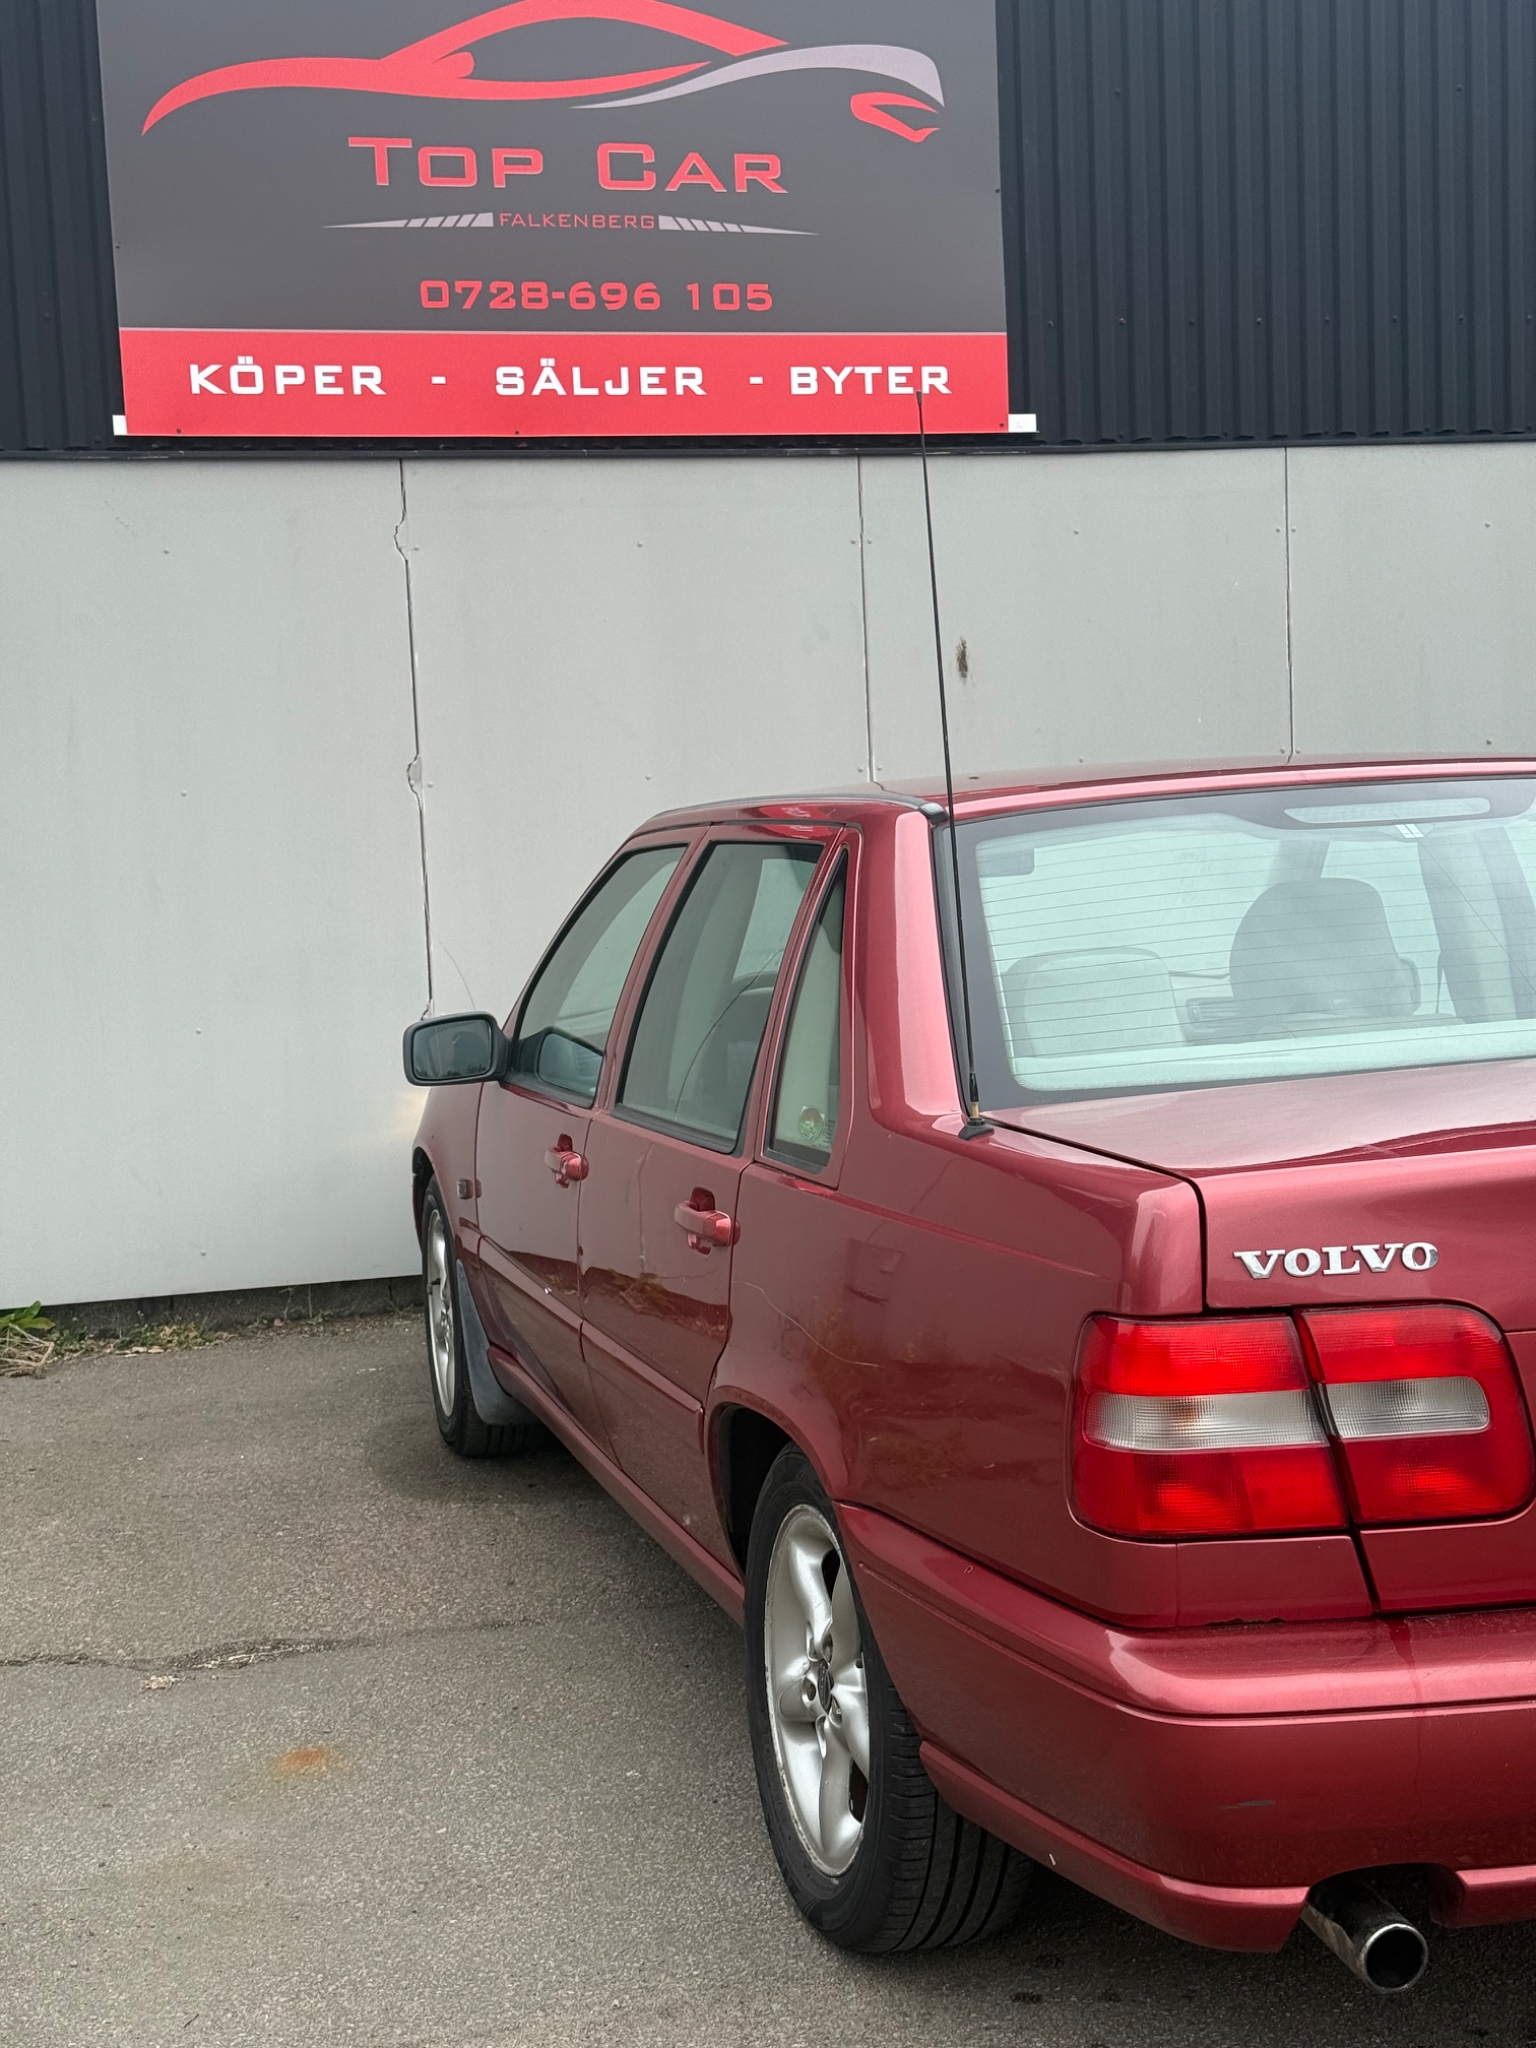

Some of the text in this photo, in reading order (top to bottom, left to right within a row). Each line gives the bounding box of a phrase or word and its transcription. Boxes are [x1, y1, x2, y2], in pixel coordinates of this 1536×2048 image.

[348, 136, 788, 193] TOP CAR
[499, 212, 655, 230] FALKENBERG
[420, 280, 773, 312] 0728-696 105
[189, 355, 387, 395] KÖPER
[495, 358, 708, 396] SÄLJER
[790, 366, 953, 395] BYTER
[1233, 1241, 1439, 1280] VOLVO
